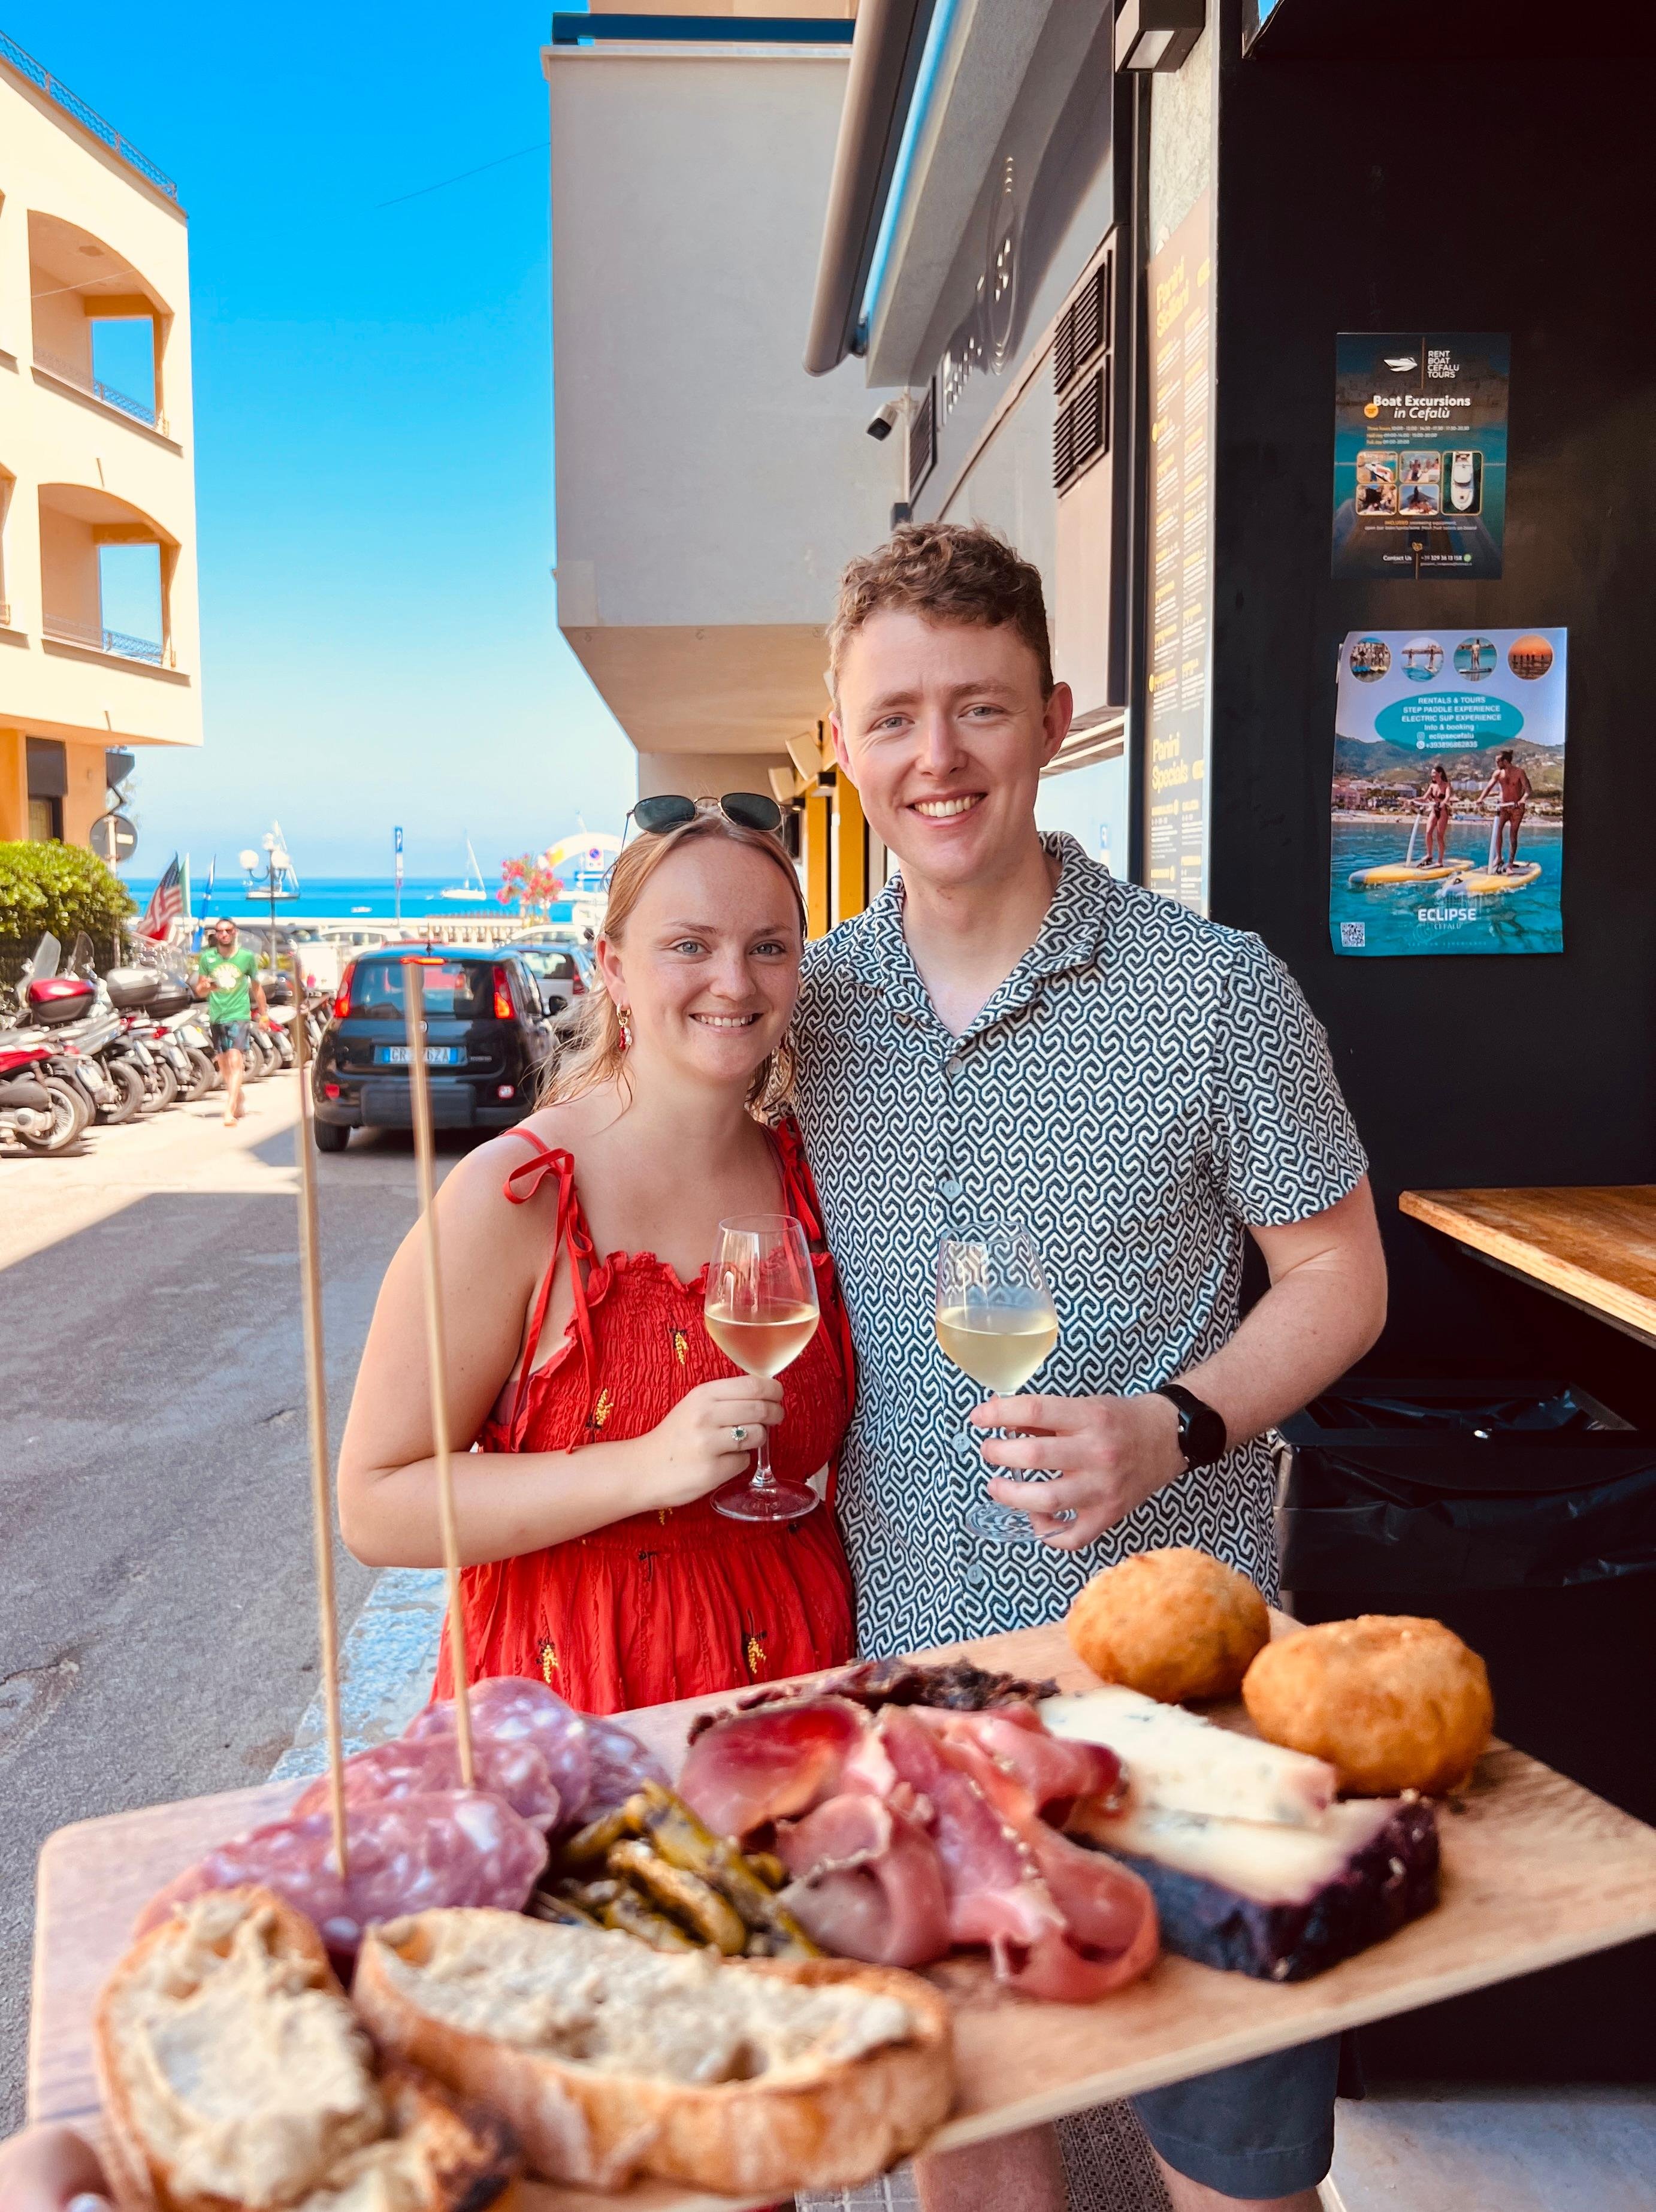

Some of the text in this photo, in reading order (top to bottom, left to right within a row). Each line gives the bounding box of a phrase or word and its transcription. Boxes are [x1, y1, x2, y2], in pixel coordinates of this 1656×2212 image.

[1373, 395, 1471, 407] Boat Excursions
[1394, 407, 1450, 421] in Cefalù
[1153, 732, 1179, 762] Panini
[1152, 759, 1188, 794] Specials
[397, 829, 402, 850] P
[1418, 908, 1476, 921] ECLIPSE
